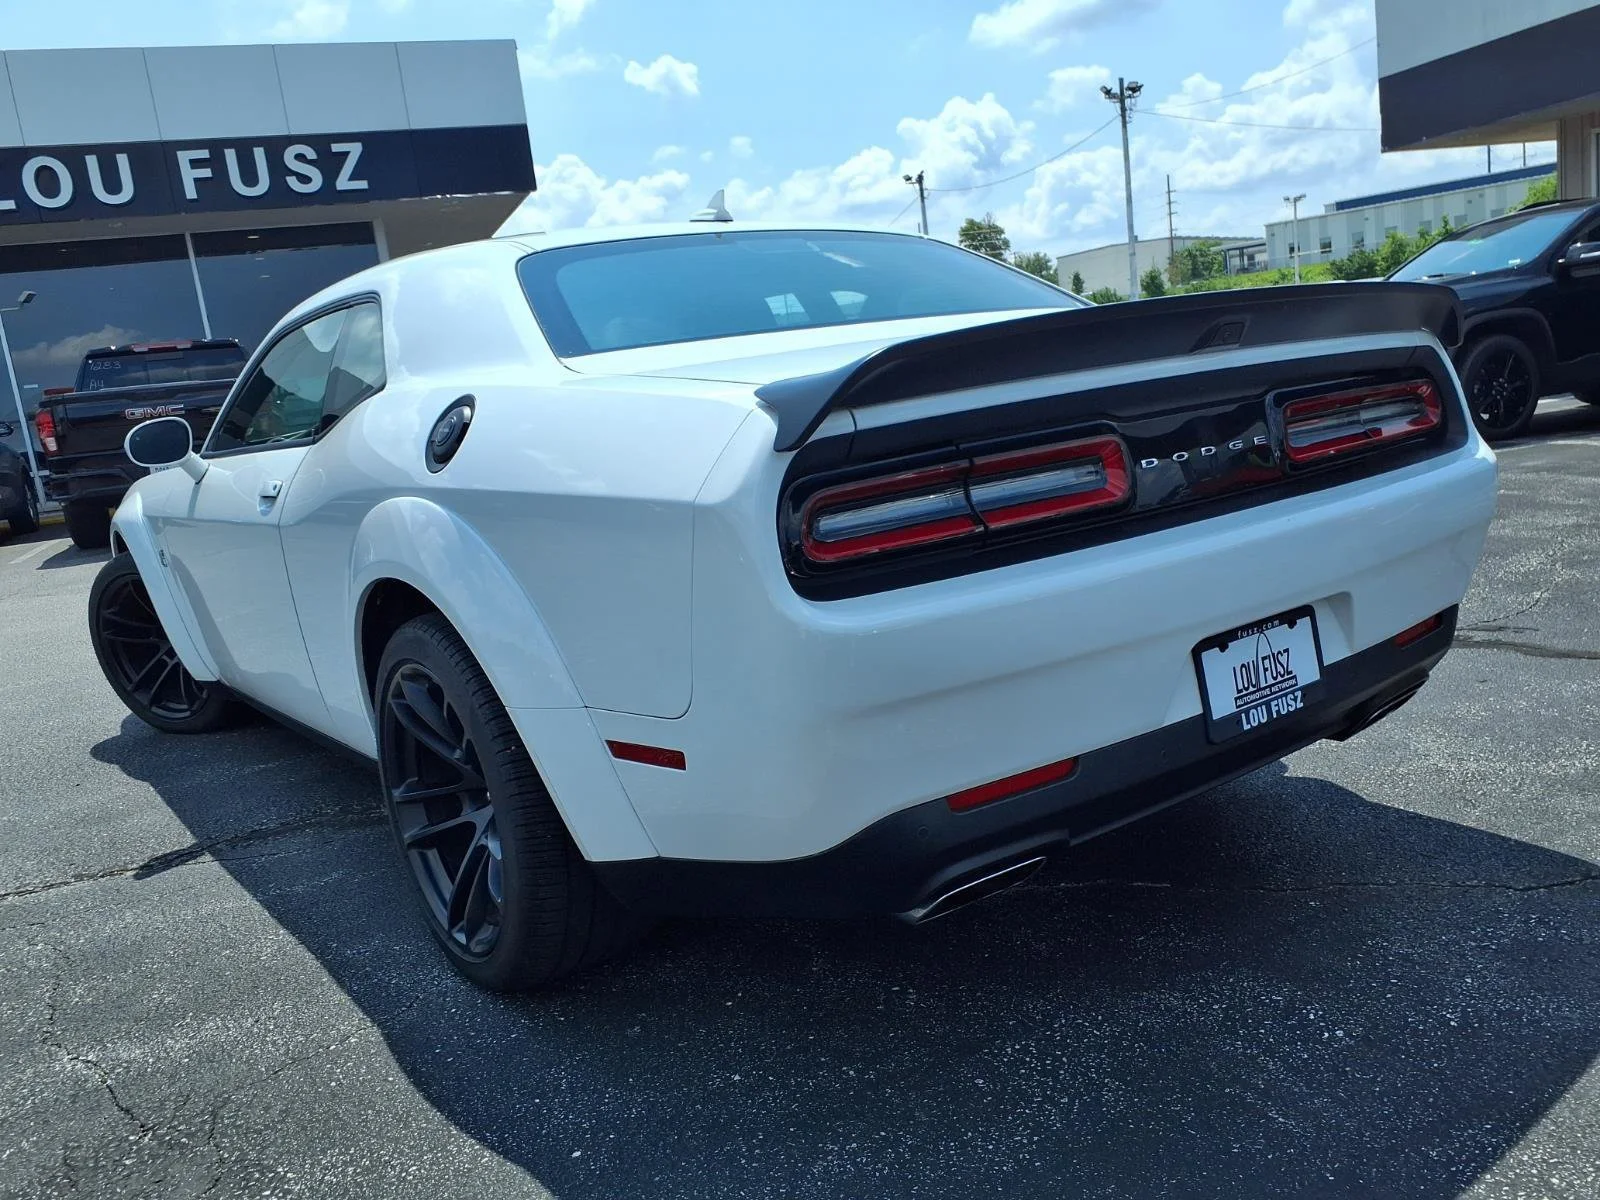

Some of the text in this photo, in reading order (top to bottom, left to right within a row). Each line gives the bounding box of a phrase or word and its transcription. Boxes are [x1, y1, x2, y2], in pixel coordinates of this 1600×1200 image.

[0, 142, 369, 209] OU FUSZ
[125, 404, 185, 419] GMC
[1141, 435, 1267, 469] DODGE
[1237, 620, 1280, 638] fusz.com
[1233, 648, 1293, 694] LOU FUSZ
[1236, 678, 1297, 706] AUTOMOTIVE NETWORK
[1241, 690, 1304, 731] LOU FUSZ
